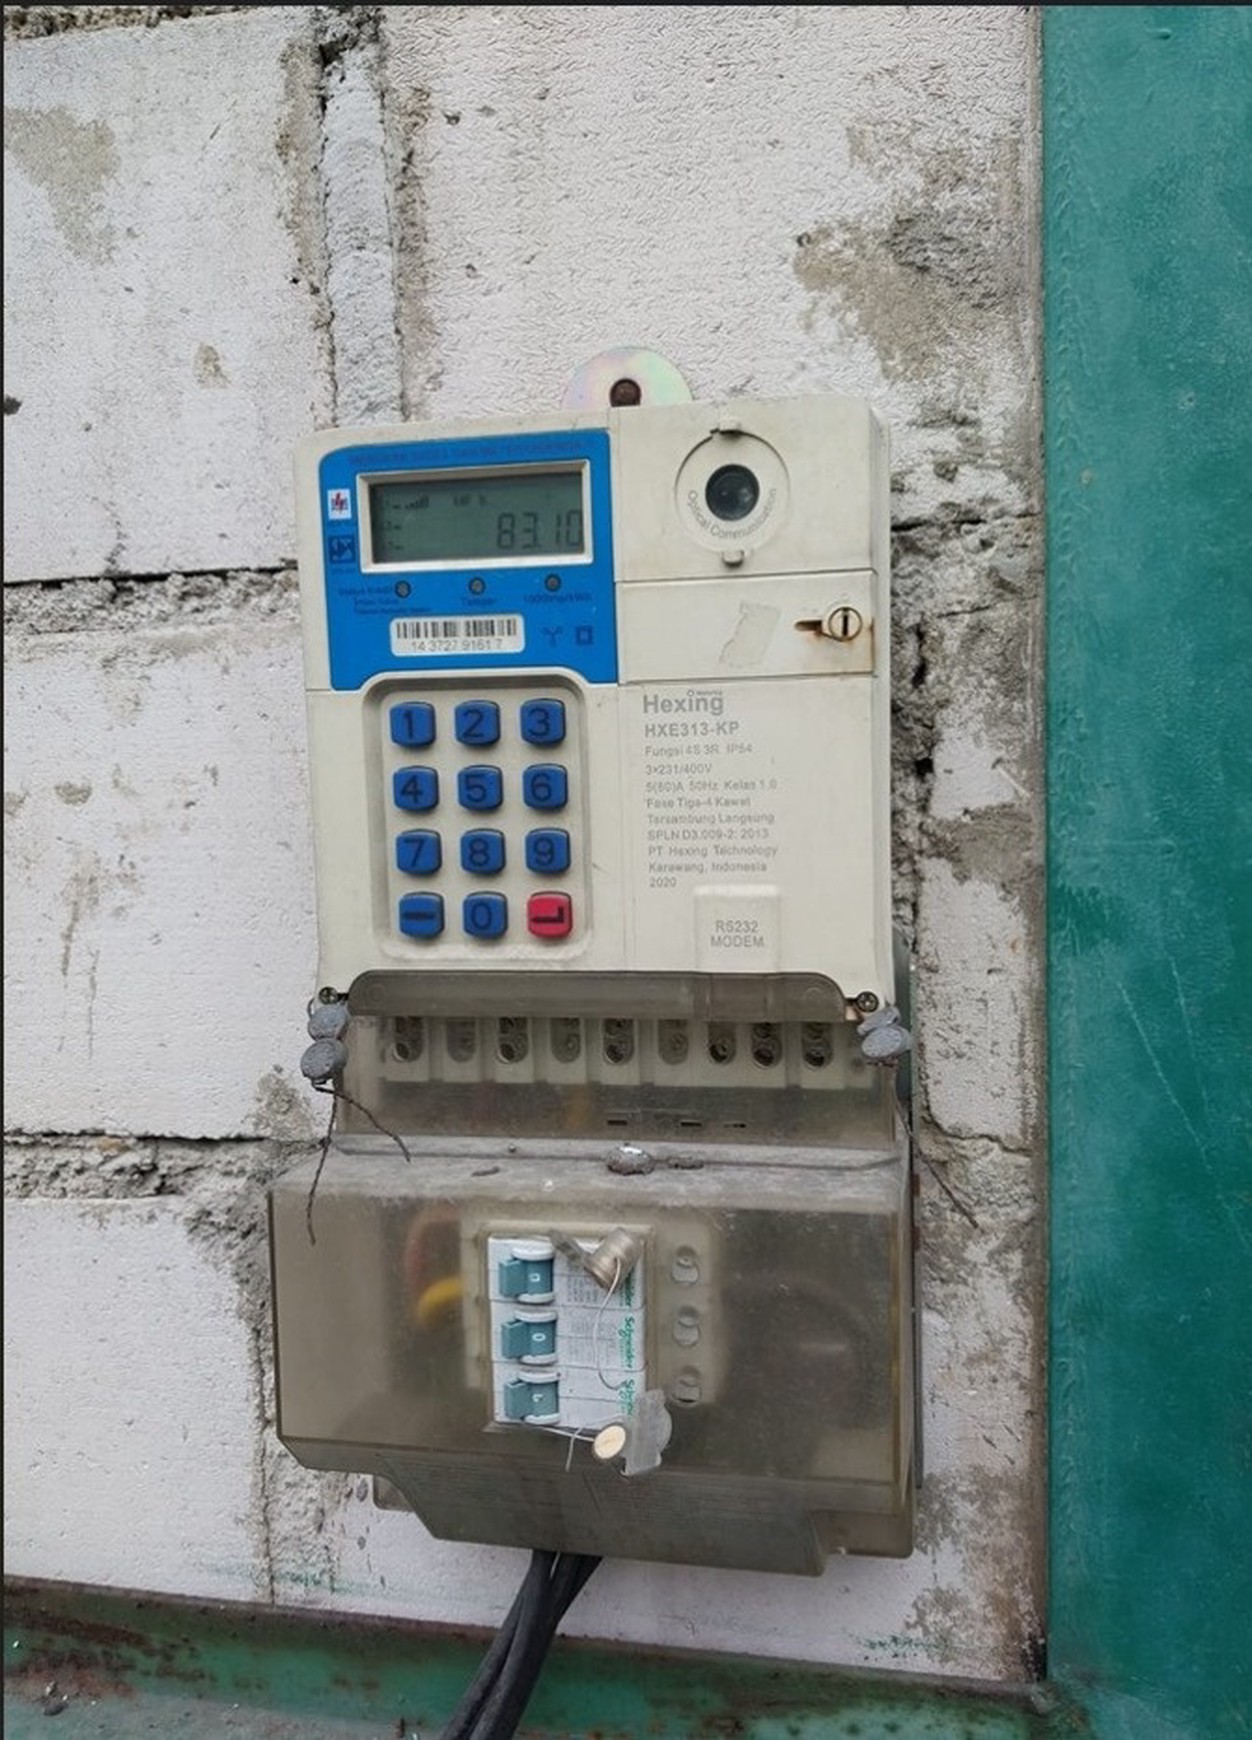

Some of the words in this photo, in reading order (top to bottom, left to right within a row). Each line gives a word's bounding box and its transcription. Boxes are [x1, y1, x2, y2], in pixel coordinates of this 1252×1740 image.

[411, 641, 426, 652] 14
[428, 640, 458, 652] 3727
[495, 638, 503, 650] 7
[643, 690, 724, 716] Hexing
[402, 711, 415, 739] 1
[462, 709, 485, 738] 2
[528, 707, 550, 737] 3
[644, 721, 740, 738] HXE313-KP
[401, 775, 423, 803] 4
[465, 774, 487, 802] 5
[530, 773, 552, 802] 6
[718, 813, 775, 825] Langsung
[647, 829, 680, 841] SPLN
[403, 838, 425, 868] 7
[468, 838, 490, 867] 8
[534, 837, 556, 867] 9
[648, 846, 663, 857] PT
[669, 846, 708, 858] Hexing
[713, 844, 779, 858] Technology
[711, 862, 767, 872] Indonesia
[649, 876, 677, 888] 2020
[470, 902, 492, 930] 0
[715, 920, 759, 934] RS232
[710, 934, 765, 948] MODEM
